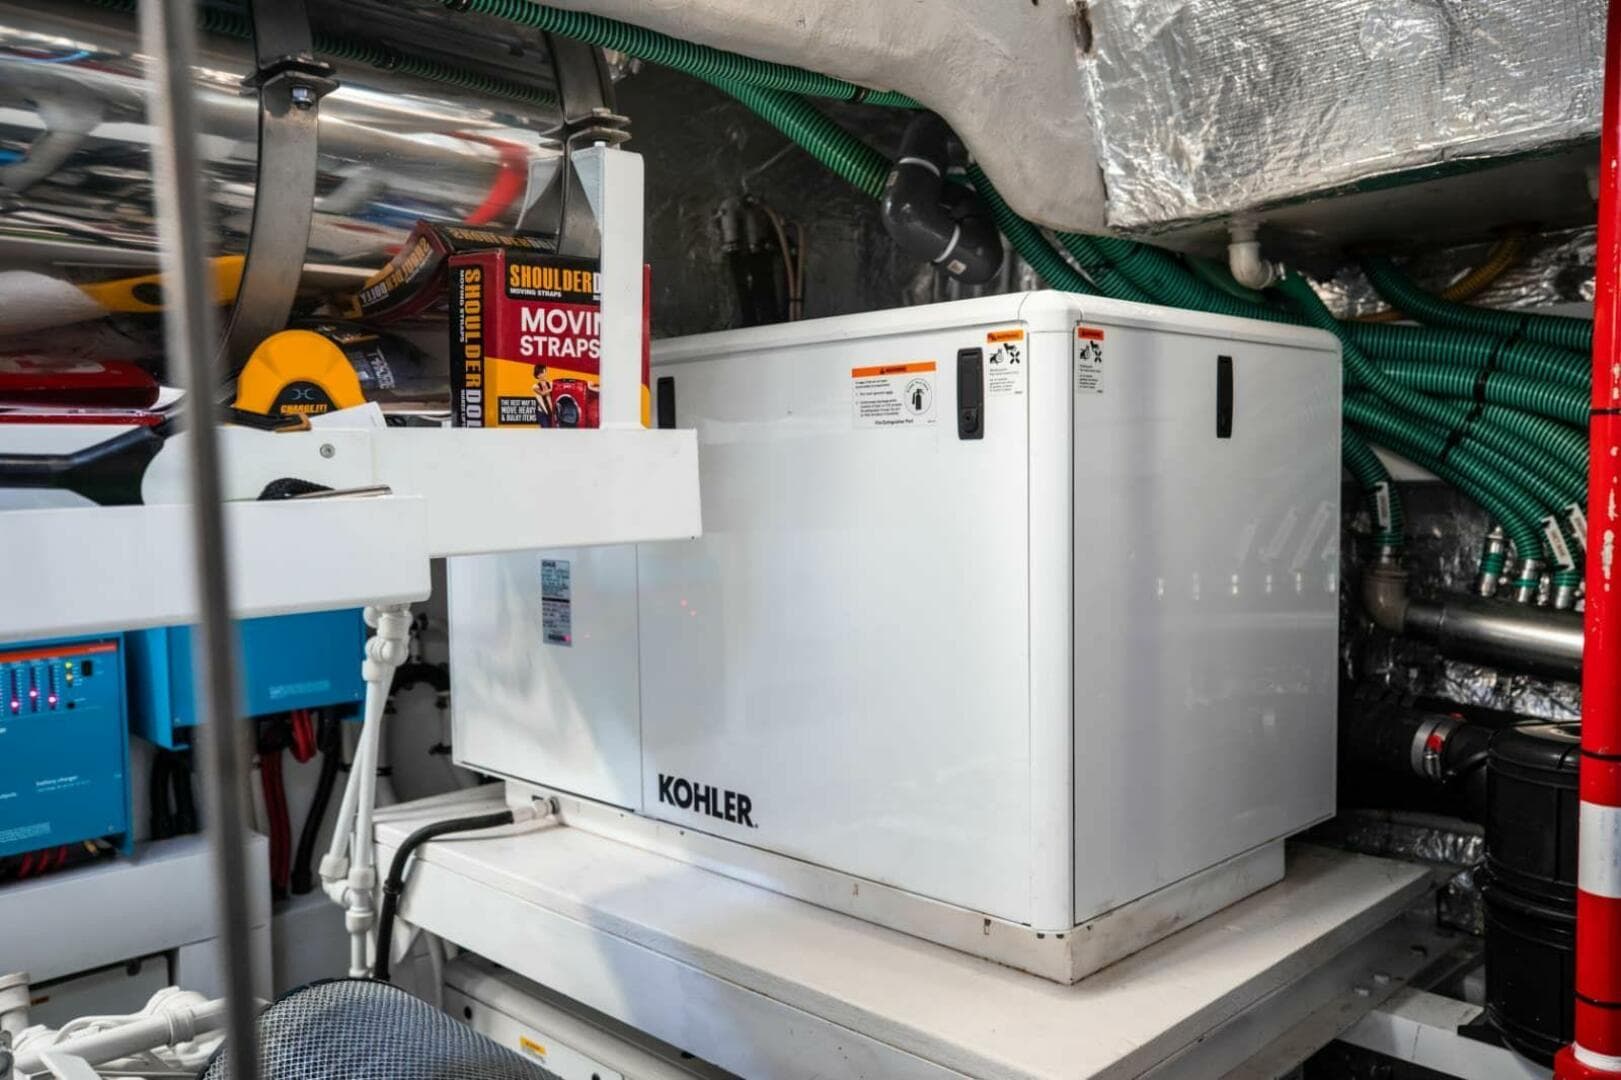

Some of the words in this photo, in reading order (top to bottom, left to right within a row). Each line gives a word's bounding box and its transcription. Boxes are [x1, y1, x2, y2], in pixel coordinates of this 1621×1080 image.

[510, 287, 536, 296] MOVING
[537, 289, 562, 298] STRAPS
[520, 335, 600, 359] STRAPS
[501, 406, 517, 414] MOVE
[519, 406, 536, 414] HEAVY
[658, 773, 755, 828] KOHLER
